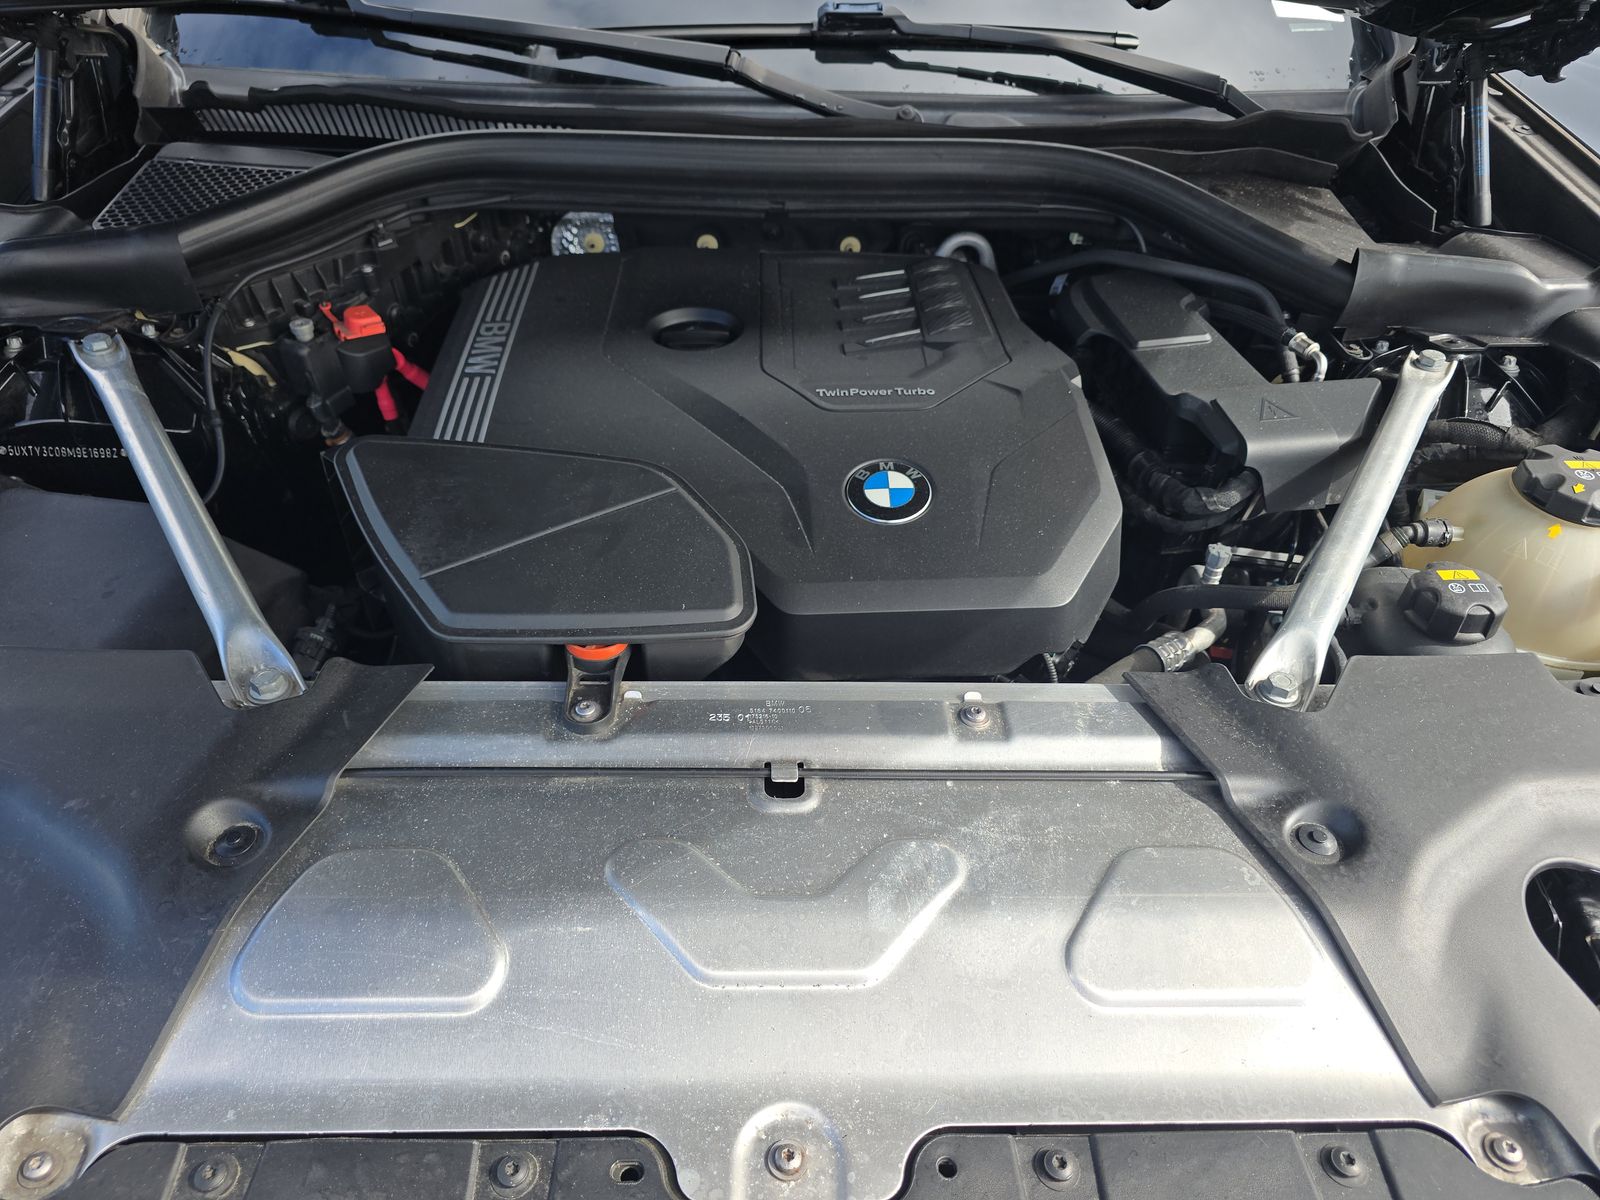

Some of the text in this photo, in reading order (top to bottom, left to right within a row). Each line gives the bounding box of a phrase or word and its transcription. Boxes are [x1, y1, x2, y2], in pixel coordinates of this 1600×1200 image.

[464, 322, 511, 374] BMW
[894, 387, 936, 396] Turbo
[855, 461, 922, 480] BMW
[708, 713, 731, 722] 235
